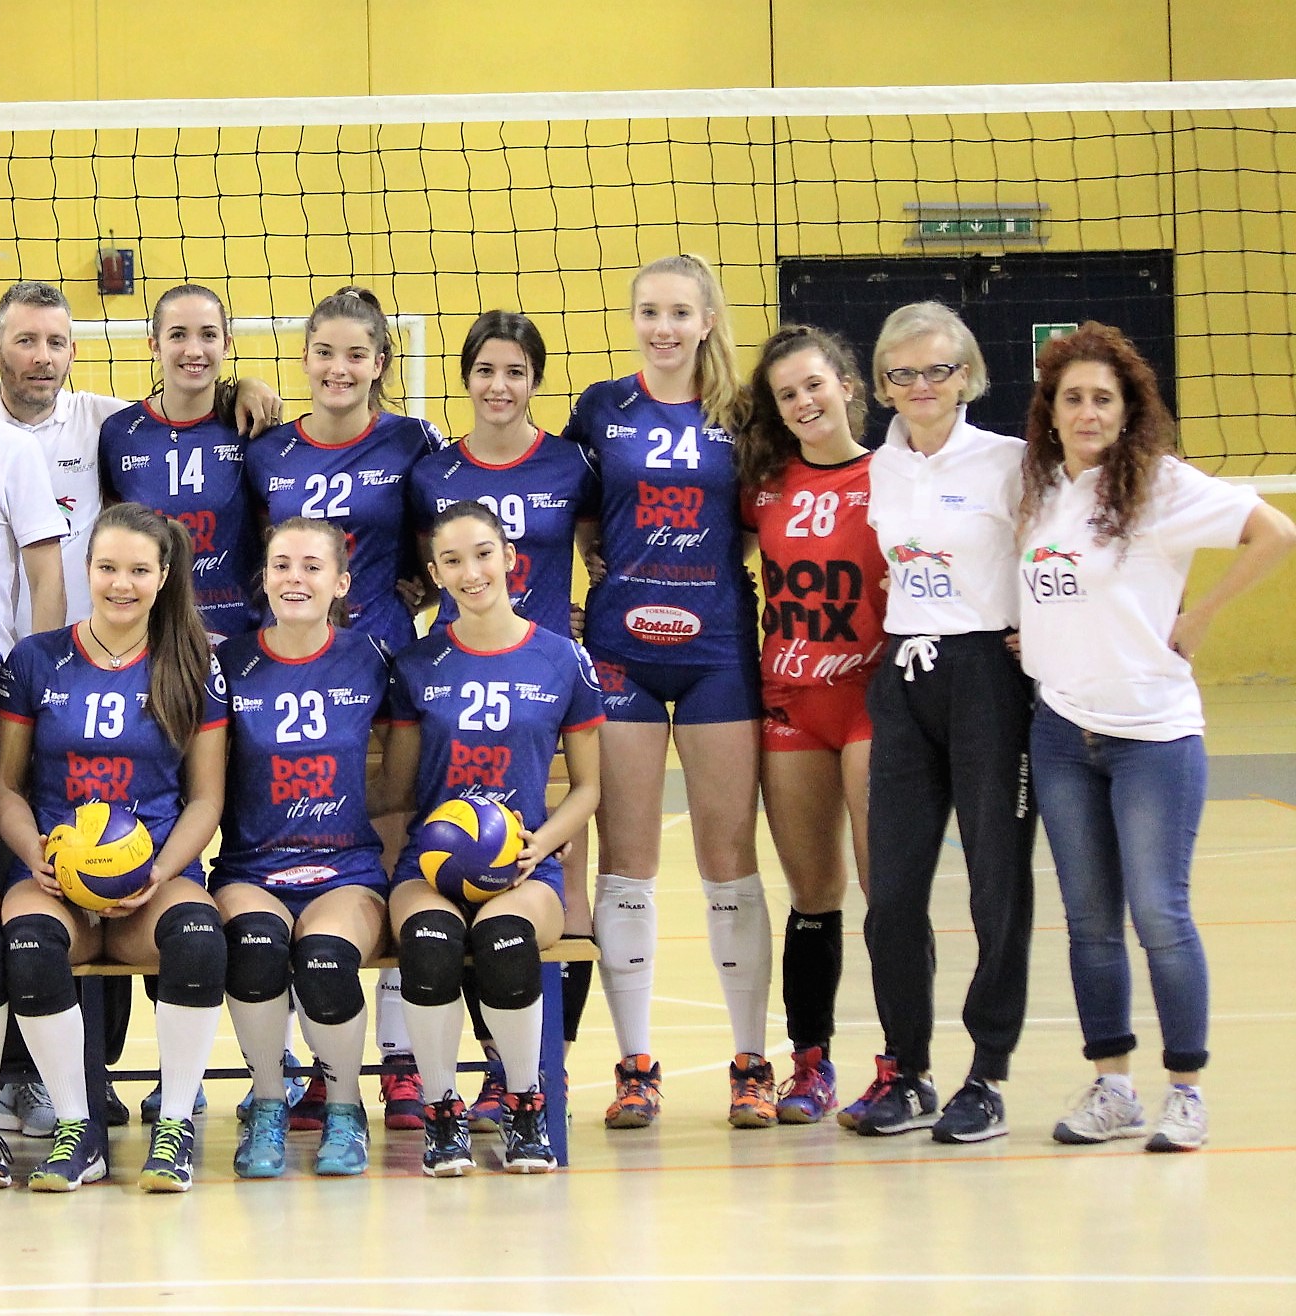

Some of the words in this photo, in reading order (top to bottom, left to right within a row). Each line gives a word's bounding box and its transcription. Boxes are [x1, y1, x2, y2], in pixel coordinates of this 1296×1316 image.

[646, 426, 701, 469] 24
[57, 457, 82, 467] TEAM
[165, 447, 205, 496] 14
[301, 472, 353, 519] 22
[526, 493, 553, 501] TEAM
[637, 480, 704, 507] bon
[786, 490, 840, 537] 28
[646, 526, 670, 546] it's
[672, 528, 709, 554] me!
[192, 550, 229, 577] me!
[761, 556, 864, 600] bon
[633, 616, 694, 634] Botalla
[772, 638, 810, 678] it's
[812, 641, 883, 686] me!
[83, 692, 126, 739] 13
[275, 690, 328, 744] 23
[459, 681, 511, 731] 25
[66, 751, 134, 778] bon
[451, 739, 512, 767] bon
[271, 754, 337, 781] bon
[286, 796, 309, 818] it's
[309, 795, 347, 822] me!
[618, 901, 646, 910] MIKASA
[182, 921, 214, 933] MIKASA
[241, 933, 272, 944] MIKASA
[415, 926, 448, 940] MIKASA
[9, 938, 40, 950] MIKASA
[493, 936, 525, 951] MIKASA
[307, 958, 338, 969] MIKASA
